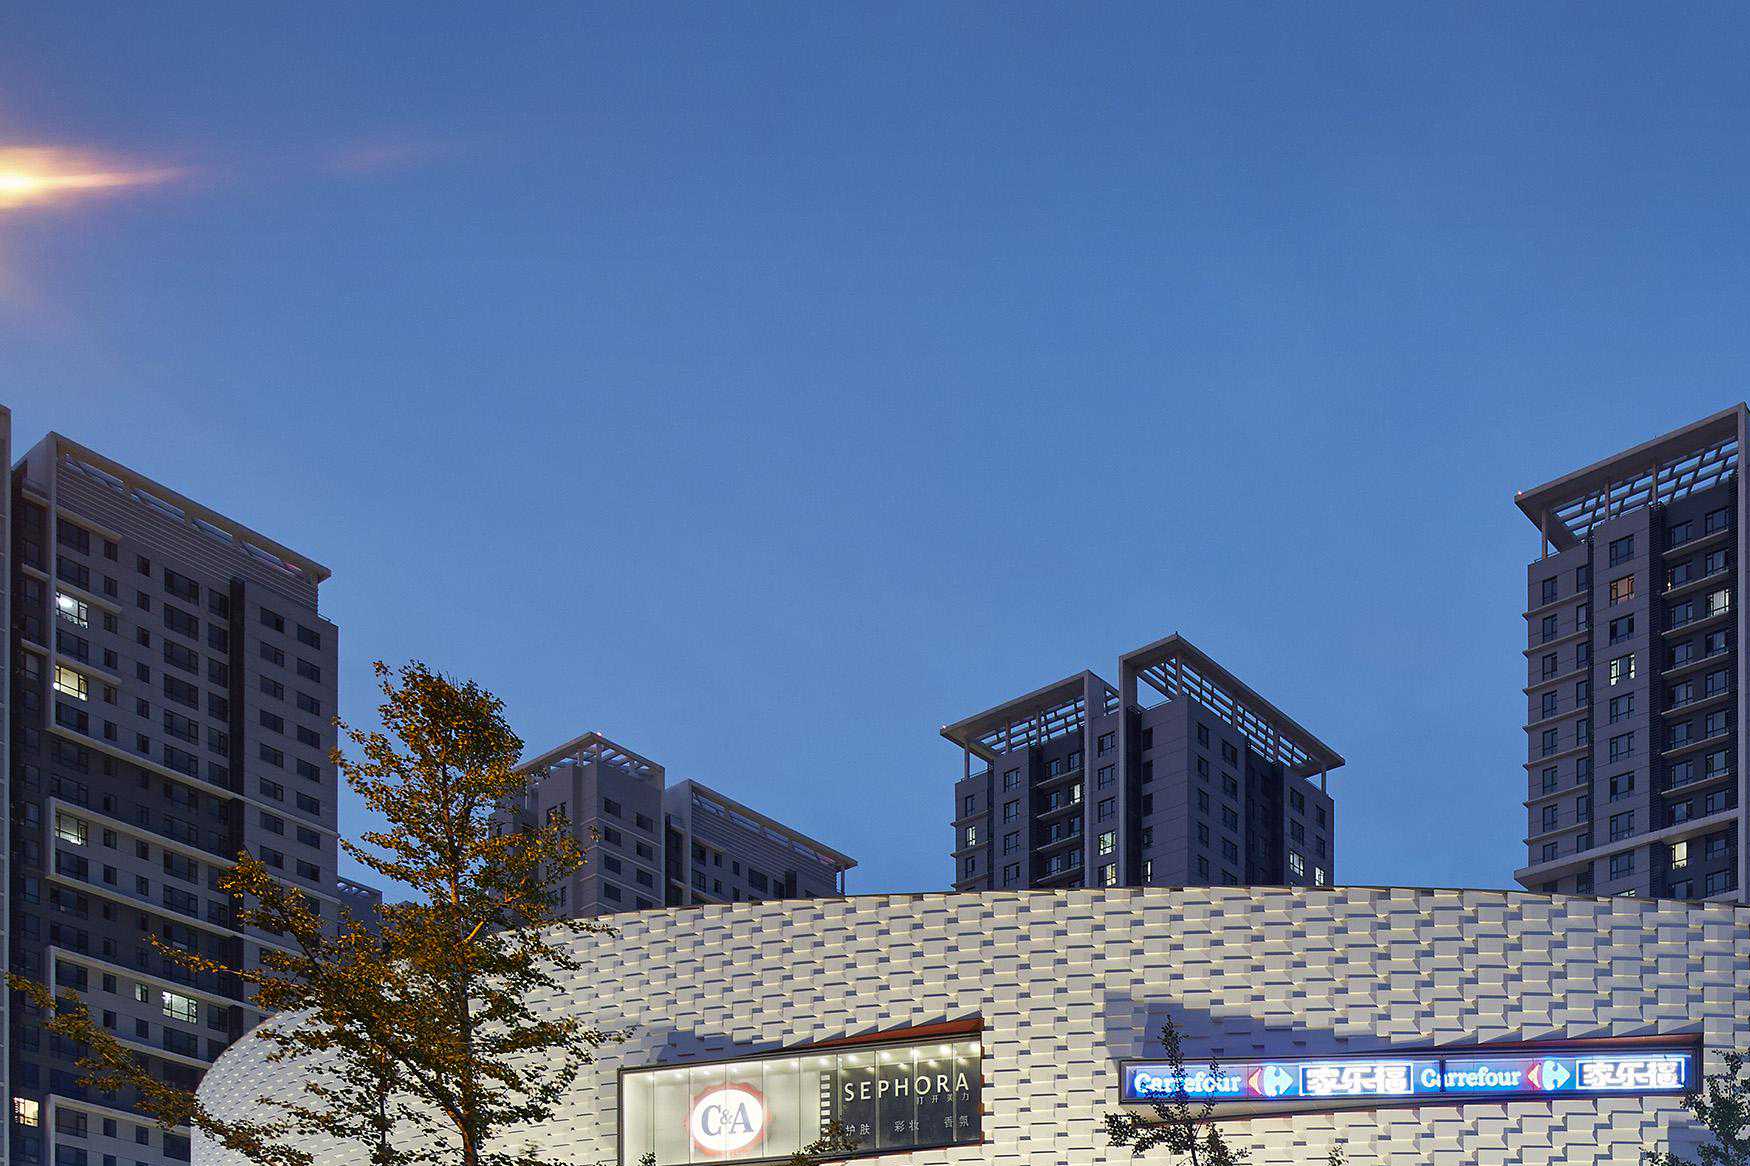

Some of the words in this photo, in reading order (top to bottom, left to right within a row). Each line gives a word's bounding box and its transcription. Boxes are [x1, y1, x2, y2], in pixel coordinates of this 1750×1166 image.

[844, 1072, 969, 1102] SEPHORA
[1306, 1066, 1409, 1093] 家乐福
[1582, 1061, 1679, 1087] 家乐福
[701, 1102, 754, 1136] C&A
